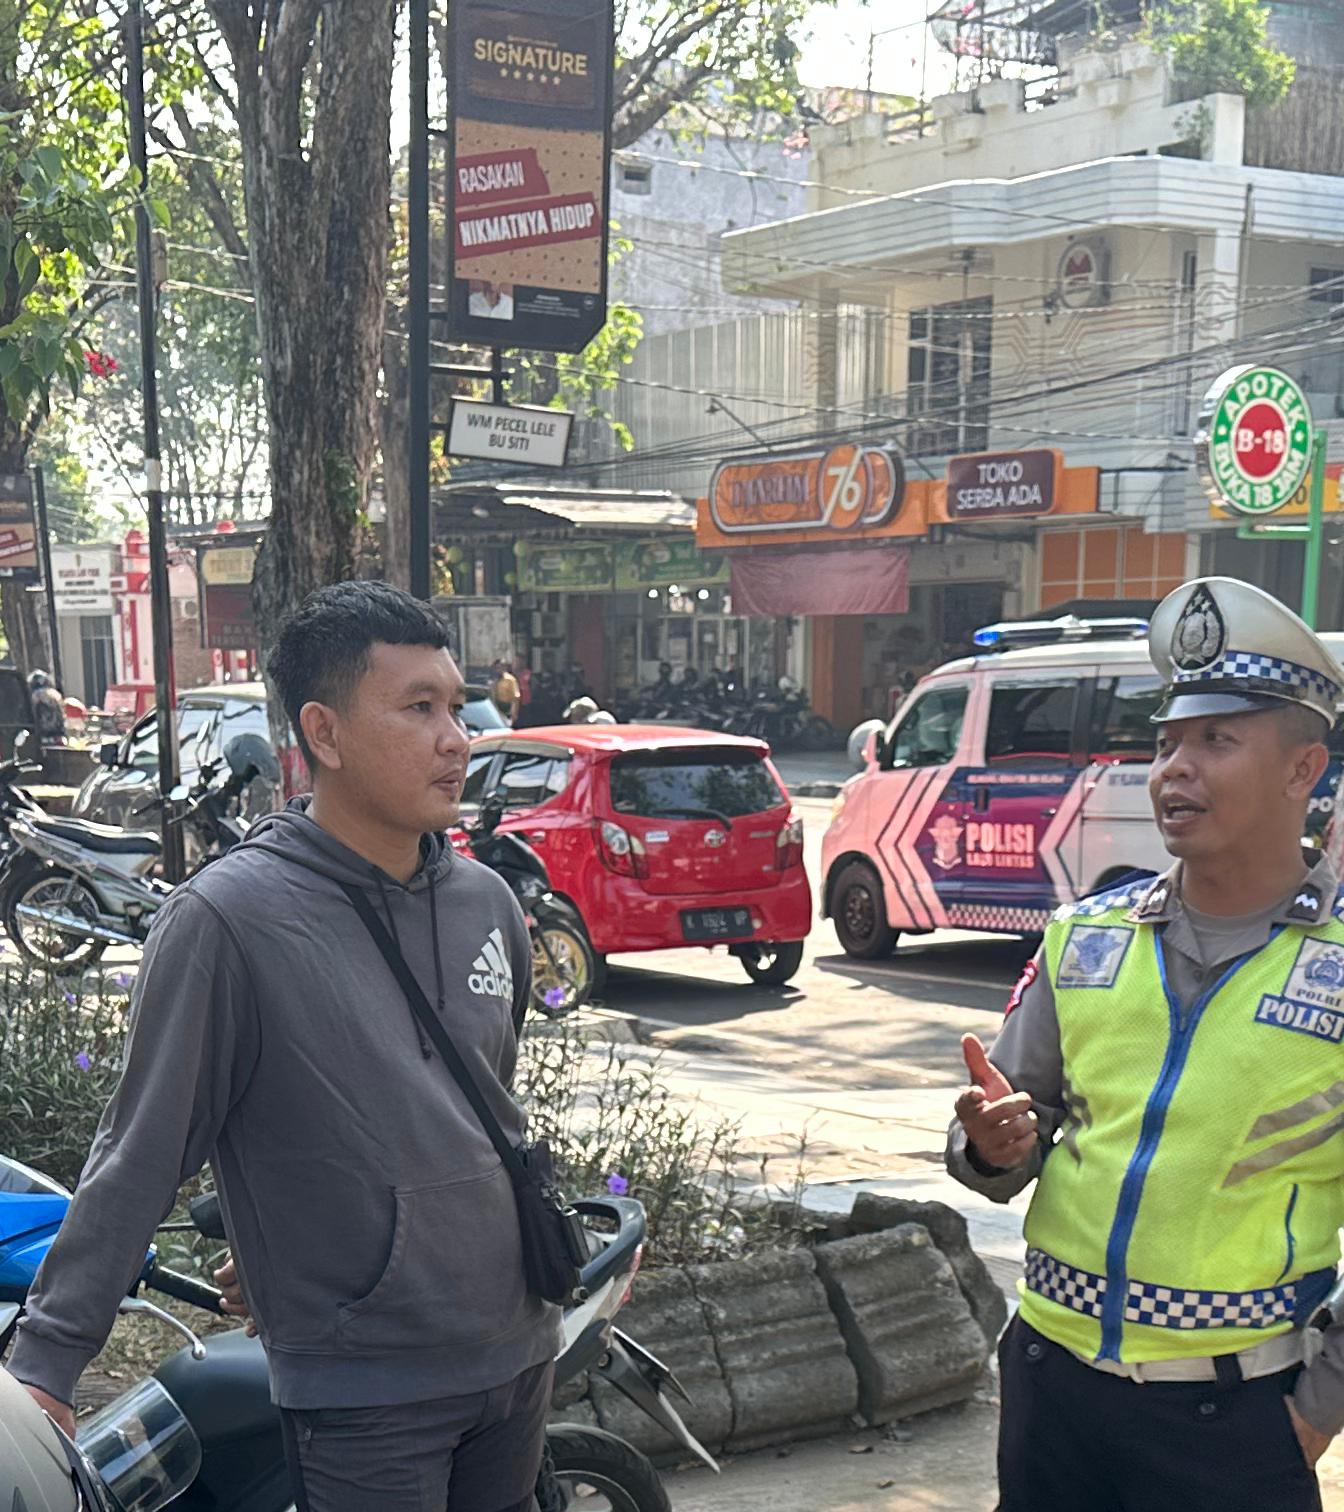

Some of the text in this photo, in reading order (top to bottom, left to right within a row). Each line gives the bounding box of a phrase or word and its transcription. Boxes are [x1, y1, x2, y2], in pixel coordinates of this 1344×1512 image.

[474, 38, 587, 75] SIGNATURE
[458, 161, 524, 193] RASAKAN
[459, 202, 595, 247] NIKMATNYA HIDUP
[1224, 374, 1306, 424] APOTEK
[495, 416, 528, 434] PECEL
[530, 422, 556, 437] LELE
[1236, 428, 1286, 453] B-18
[488, 433, 530, 451] BU SITI
[823, 445, 862, 524] 76
[977, 460, 1024, 484] TOKO
[1214, 442, 1305, 507] BUKA 18 JAM
[957, 484, 1042, 510] SERBA ADA
[966, 823, 1035, 853] POLISI
[1296, 988, 1342, 1007] POLRI
